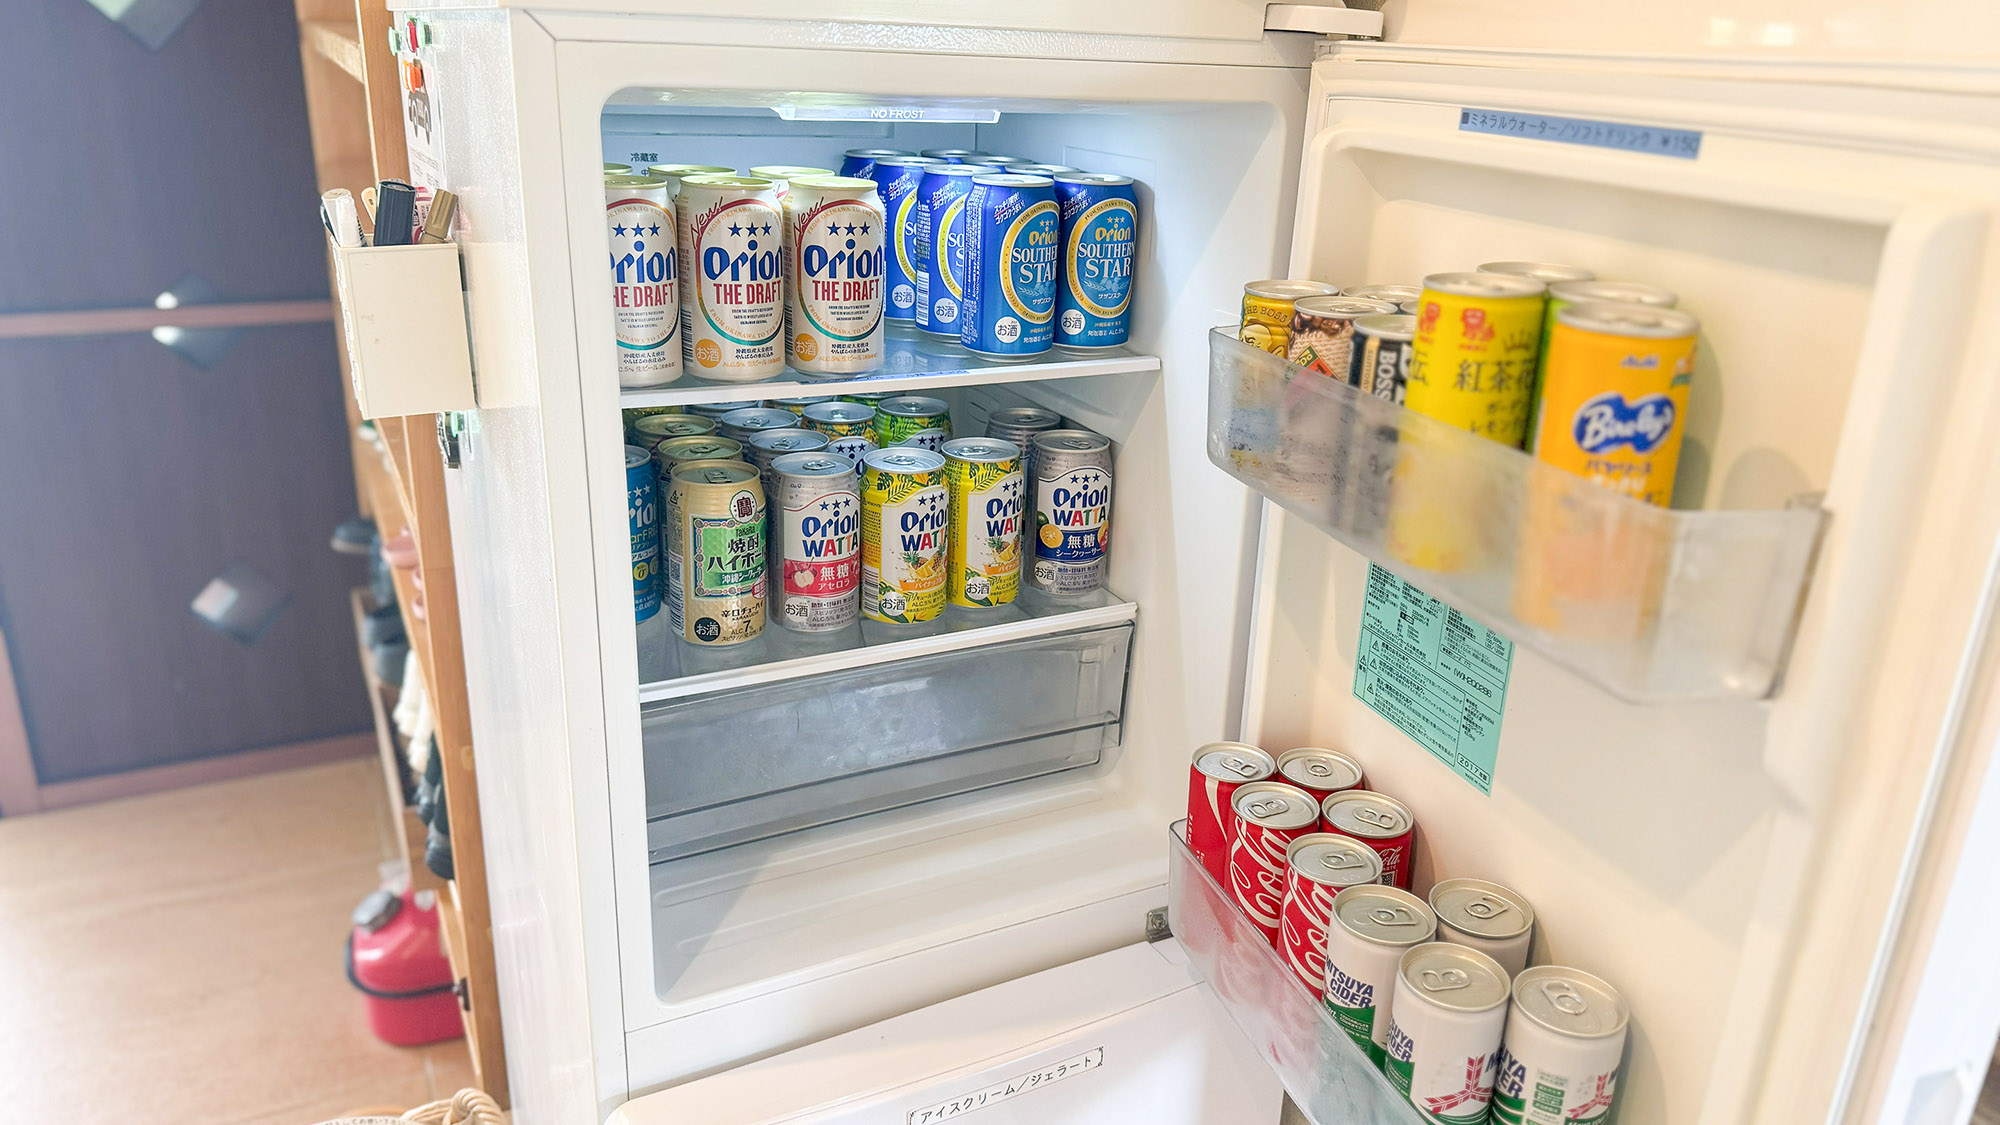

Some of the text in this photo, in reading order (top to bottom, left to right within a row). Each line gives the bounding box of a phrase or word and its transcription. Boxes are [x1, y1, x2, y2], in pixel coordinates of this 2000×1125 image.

[871, 109, 925, 119] NO FROST
[630, 152, 659, 162] 冷蔵室
[691, 196, 723, 250] New!
[793, 196, 824, 247] New!
[820, 206, 851, 220] OKINAWA
[1095, 223, 1131, 242] Orion
[803, 238, 883, 280] Orion
[1078, 242, 1135, 258] SOUTHERN
[610, 240, 677, 284] rion
[703, 239, 784, 282] Orion
[1085, 257, 1131, 279] STAR
[613, 282, 674, 308] HE DRAFT
[713, 280, 782, 305] THE DRAFT
[812, 279, 880, 302] THE DRAFT
[894, 291, 913, 303] お酒
[709, 308, 725, 327] FROM
[807, 303, 822, 322] FROM
[822, 320, 851, 335] OKINAWA
[936, 305, 956, 318] お酒
[1245, 305, 1288, 323] HE BOSS
[997, 325, 1018, 337] お酒
[1062, 316, 1083, 330] お酒
[696, 346, 719, 362] お酒
[795, 340, 816, 356] お酒
[1376, 350, 1398, 400] BOSS
[986, 490, 1023, 519] Orio
[1053, 484, 1108, 509] Orion
[801, 509, 859, 538] Orion
[986, 513, 1022, 538] WAT
[1052, 508, 1106, 528] WATTA
[728, 533, 760, 555] 焼酎
[802, 531, 859, 558] WATTA
[1067, 533, 1096, 549] 無糖
[820, 562, 850, 581] 無糖
[1034, 566, 1055, 581] お酒
[966, 583, 990, 595] お酒
[785, 603, 809, 618] お酒
[881, 597, 906, 611] お酒
[695, 623, 719, 637] お酒
[1326, 954, 1374, 998] MITSUYA
[1329, 978, 1373, 1009] CIDER
[921, 1056, 1092, 1124] アイスクリーム／ジェラート
